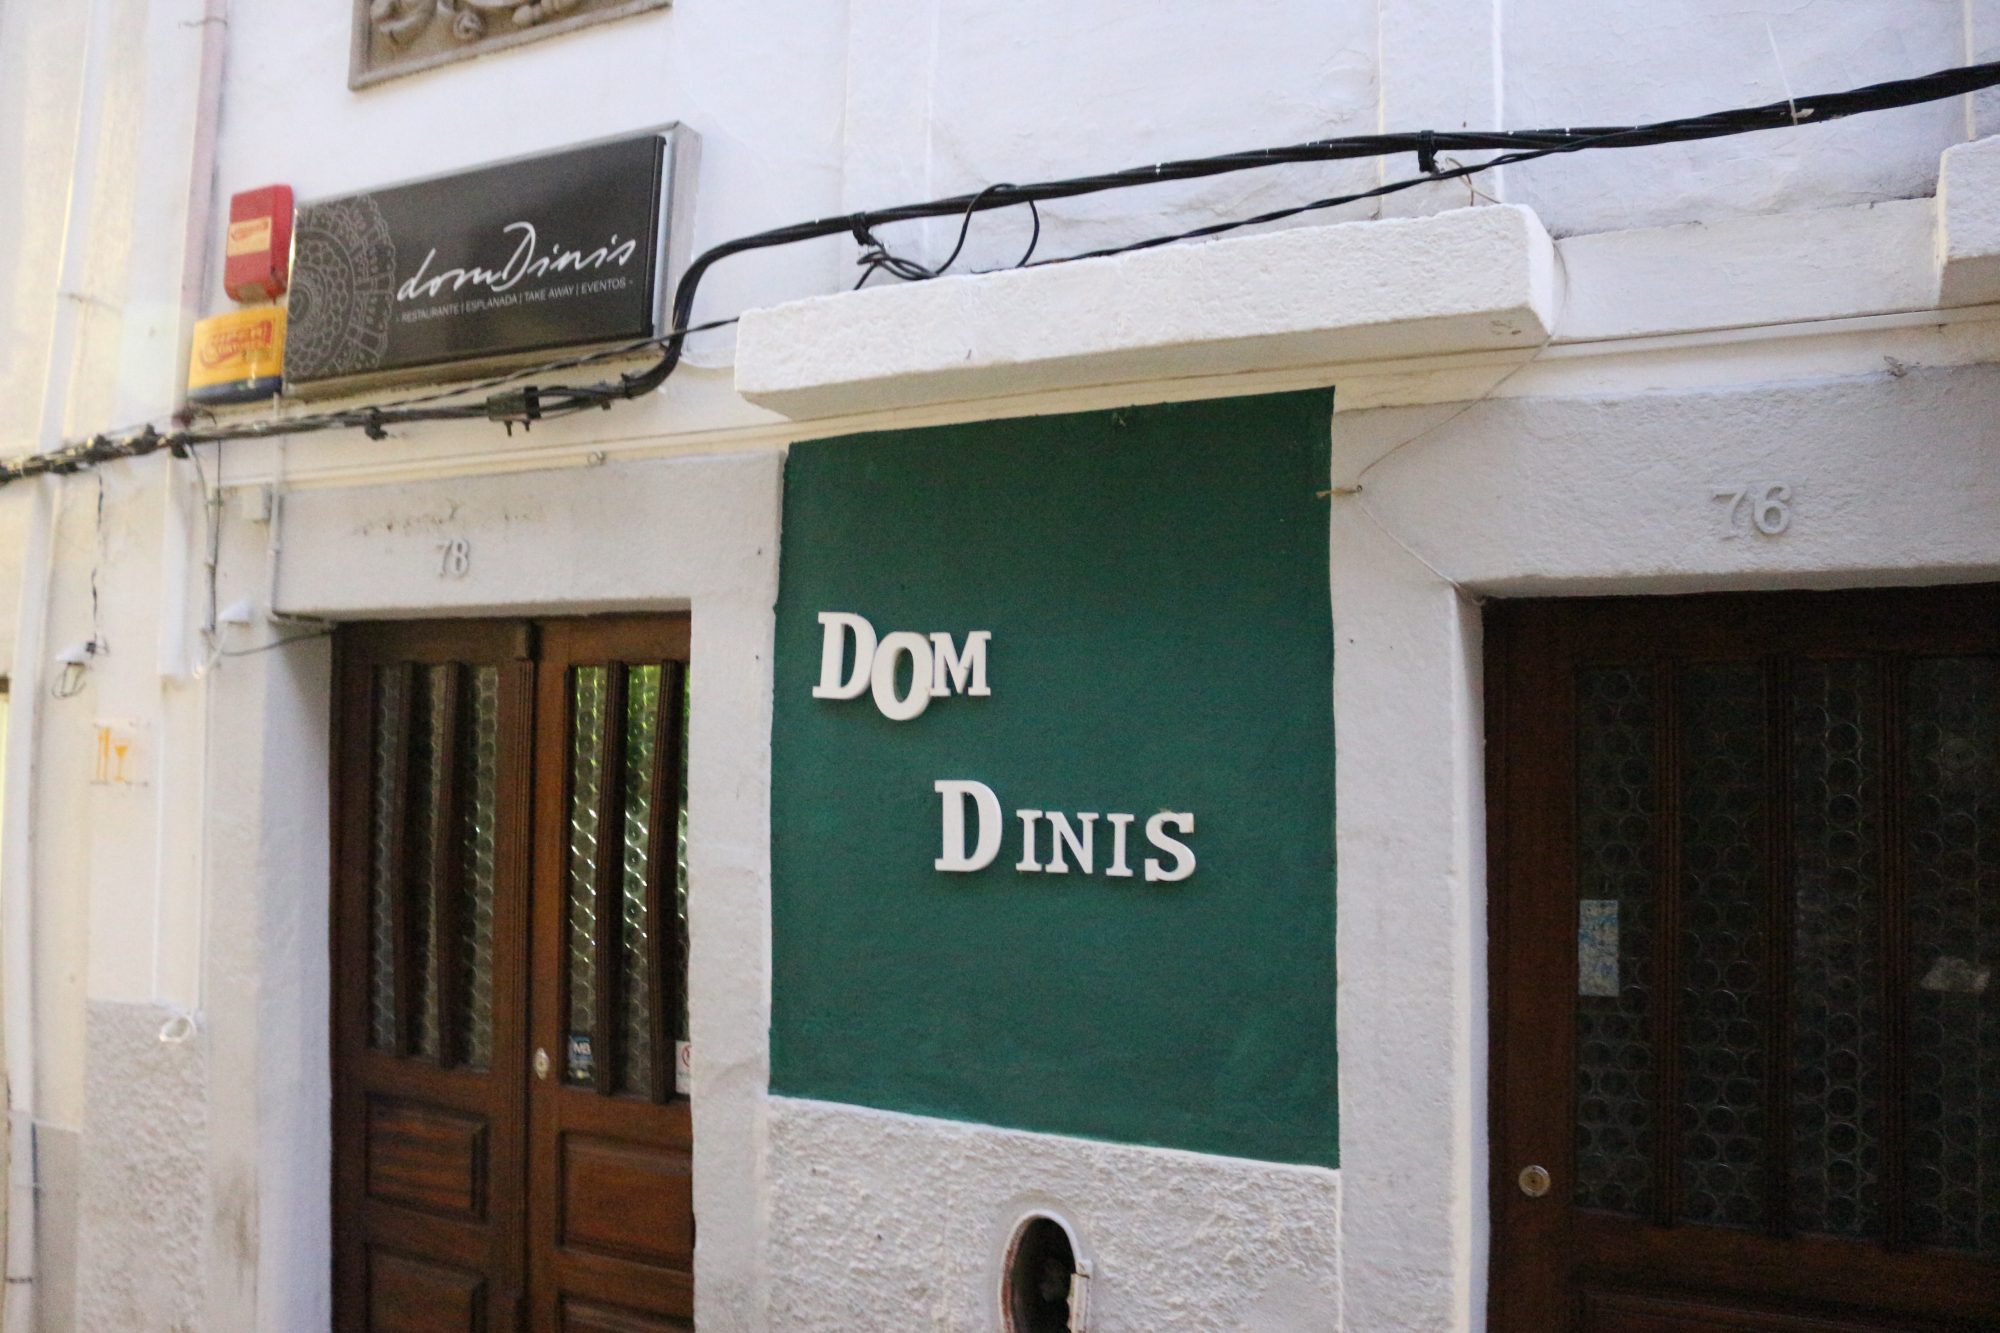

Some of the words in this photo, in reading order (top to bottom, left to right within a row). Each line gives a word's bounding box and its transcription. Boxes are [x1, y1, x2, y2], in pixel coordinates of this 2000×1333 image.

[401, 303, 460, 322] RESTAURANTE
[465, 294, 517, 313] ESPLANADA
[525, 289, 546, 302] TAKE
[548, 284, 574, 299] AWAY
[581, 277, 626, 295] EVENTOS
[1711, 481, 1792, 541] 76
[436, 538, 470, 579] 78
[812, 611, 992, 721] DOM
[934, 780, 1196, 882] DINIS
